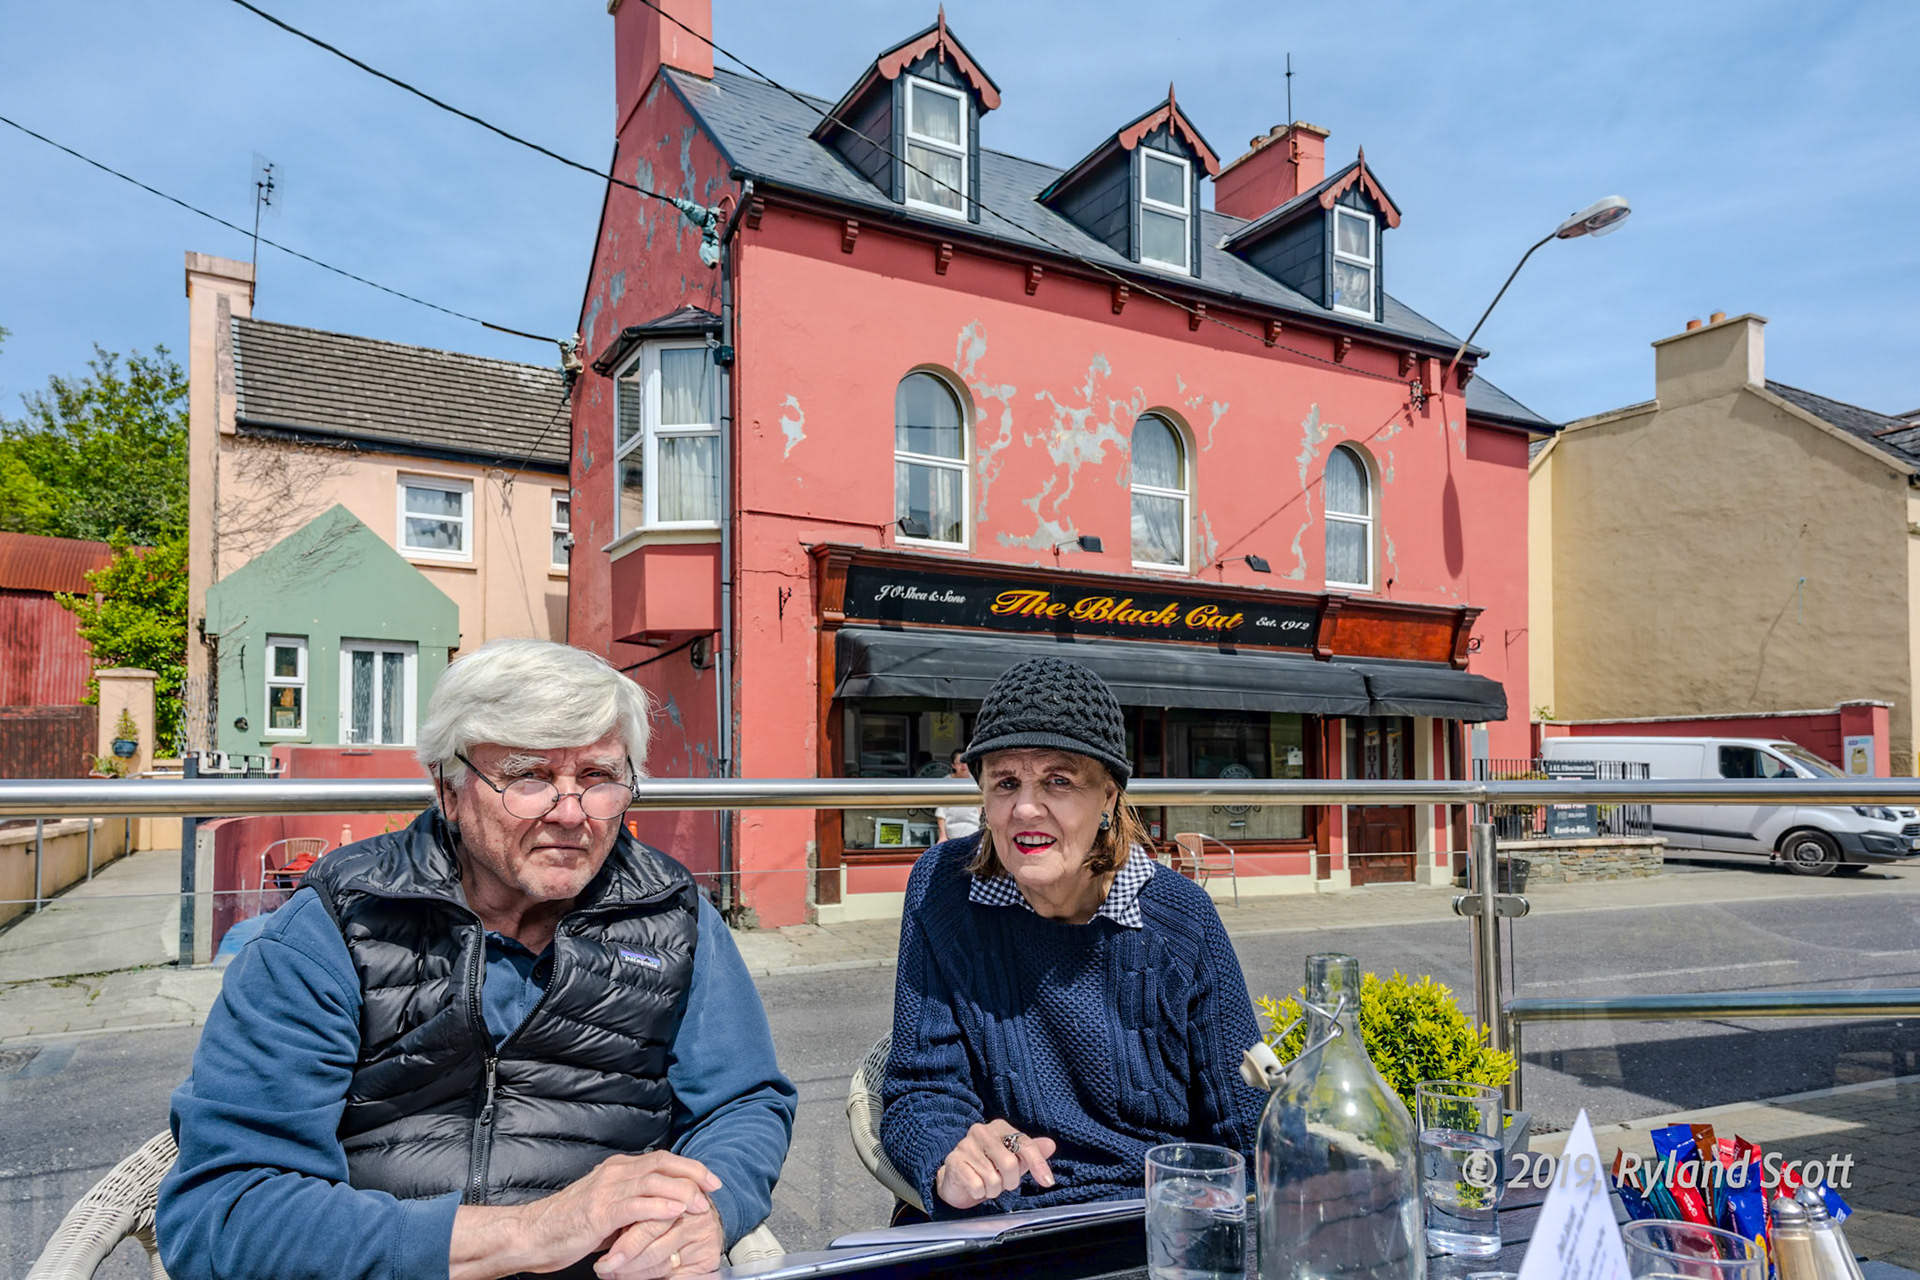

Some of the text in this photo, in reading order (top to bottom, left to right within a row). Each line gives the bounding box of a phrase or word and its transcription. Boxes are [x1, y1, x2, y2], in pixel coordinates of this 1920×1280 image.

[928, 590, 939, 602] &
[939, 589, 966, 604] Sons
[990, 589, 1244, 631] The Black Cat
[1255, 616, 1276, 627] Est.
